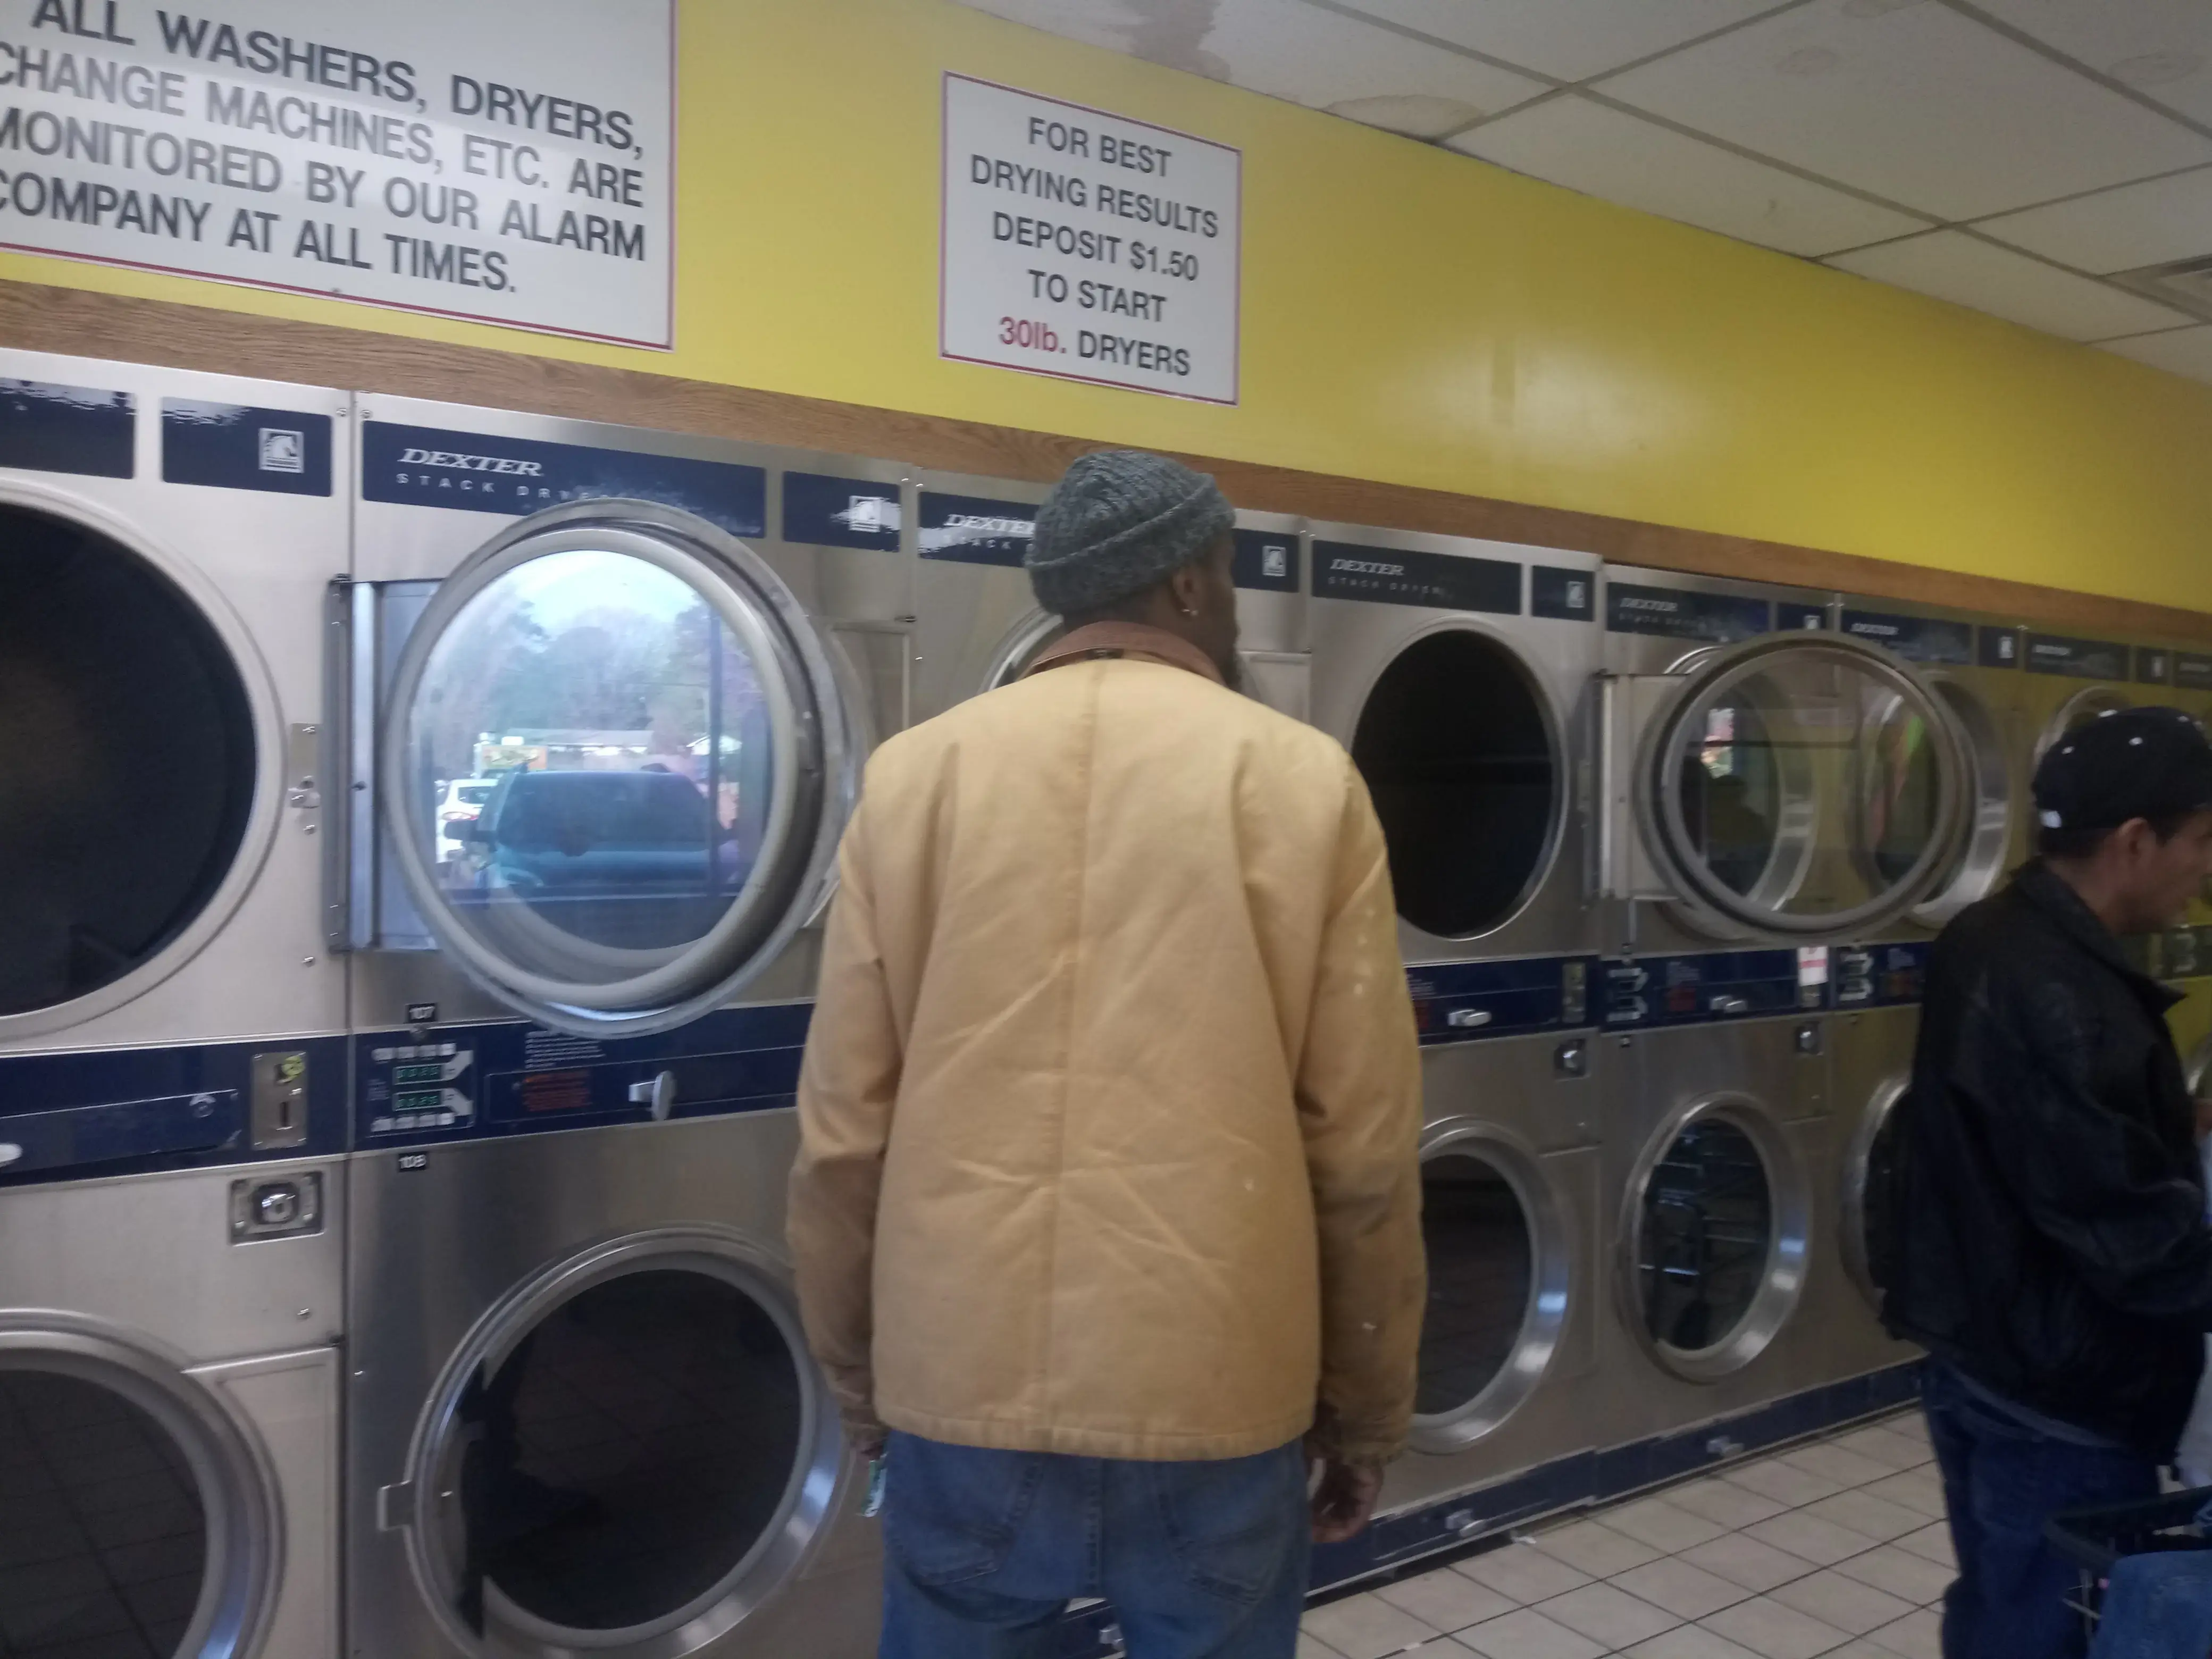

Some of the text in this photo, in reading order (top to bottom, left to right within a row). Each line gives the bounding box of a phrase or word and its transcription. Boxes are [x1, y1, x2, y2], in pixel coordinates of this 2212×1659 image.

[30, 0, 644, 160] ALL WASHERS, DRYERS,
[0, 41, 644, 208] CHANGE MACHINES, ETC. ARE
[1028, 116, 1172, 177] FOR BEST
[306, 160, 366, 208] BY
[382, 176, 479, 230] OUR
[499, 199, 646, 262] ALARM
[970, 154, 1219, 238] DRYING RESULTS
[0, 169, 516, 293] OMPANY AT ALL TIMES.
[993, 211, 1200, 281] DEPOSIT $1.50
[1027, 269, 1167, 322] TO START
[999, 316, 1191, 376] 30lb. DRYERS
[396, 473, 495, 493] STACK
[397, 448, 544, 476] DEXTER
[1330, 559, 1405, 575] DEXTER
